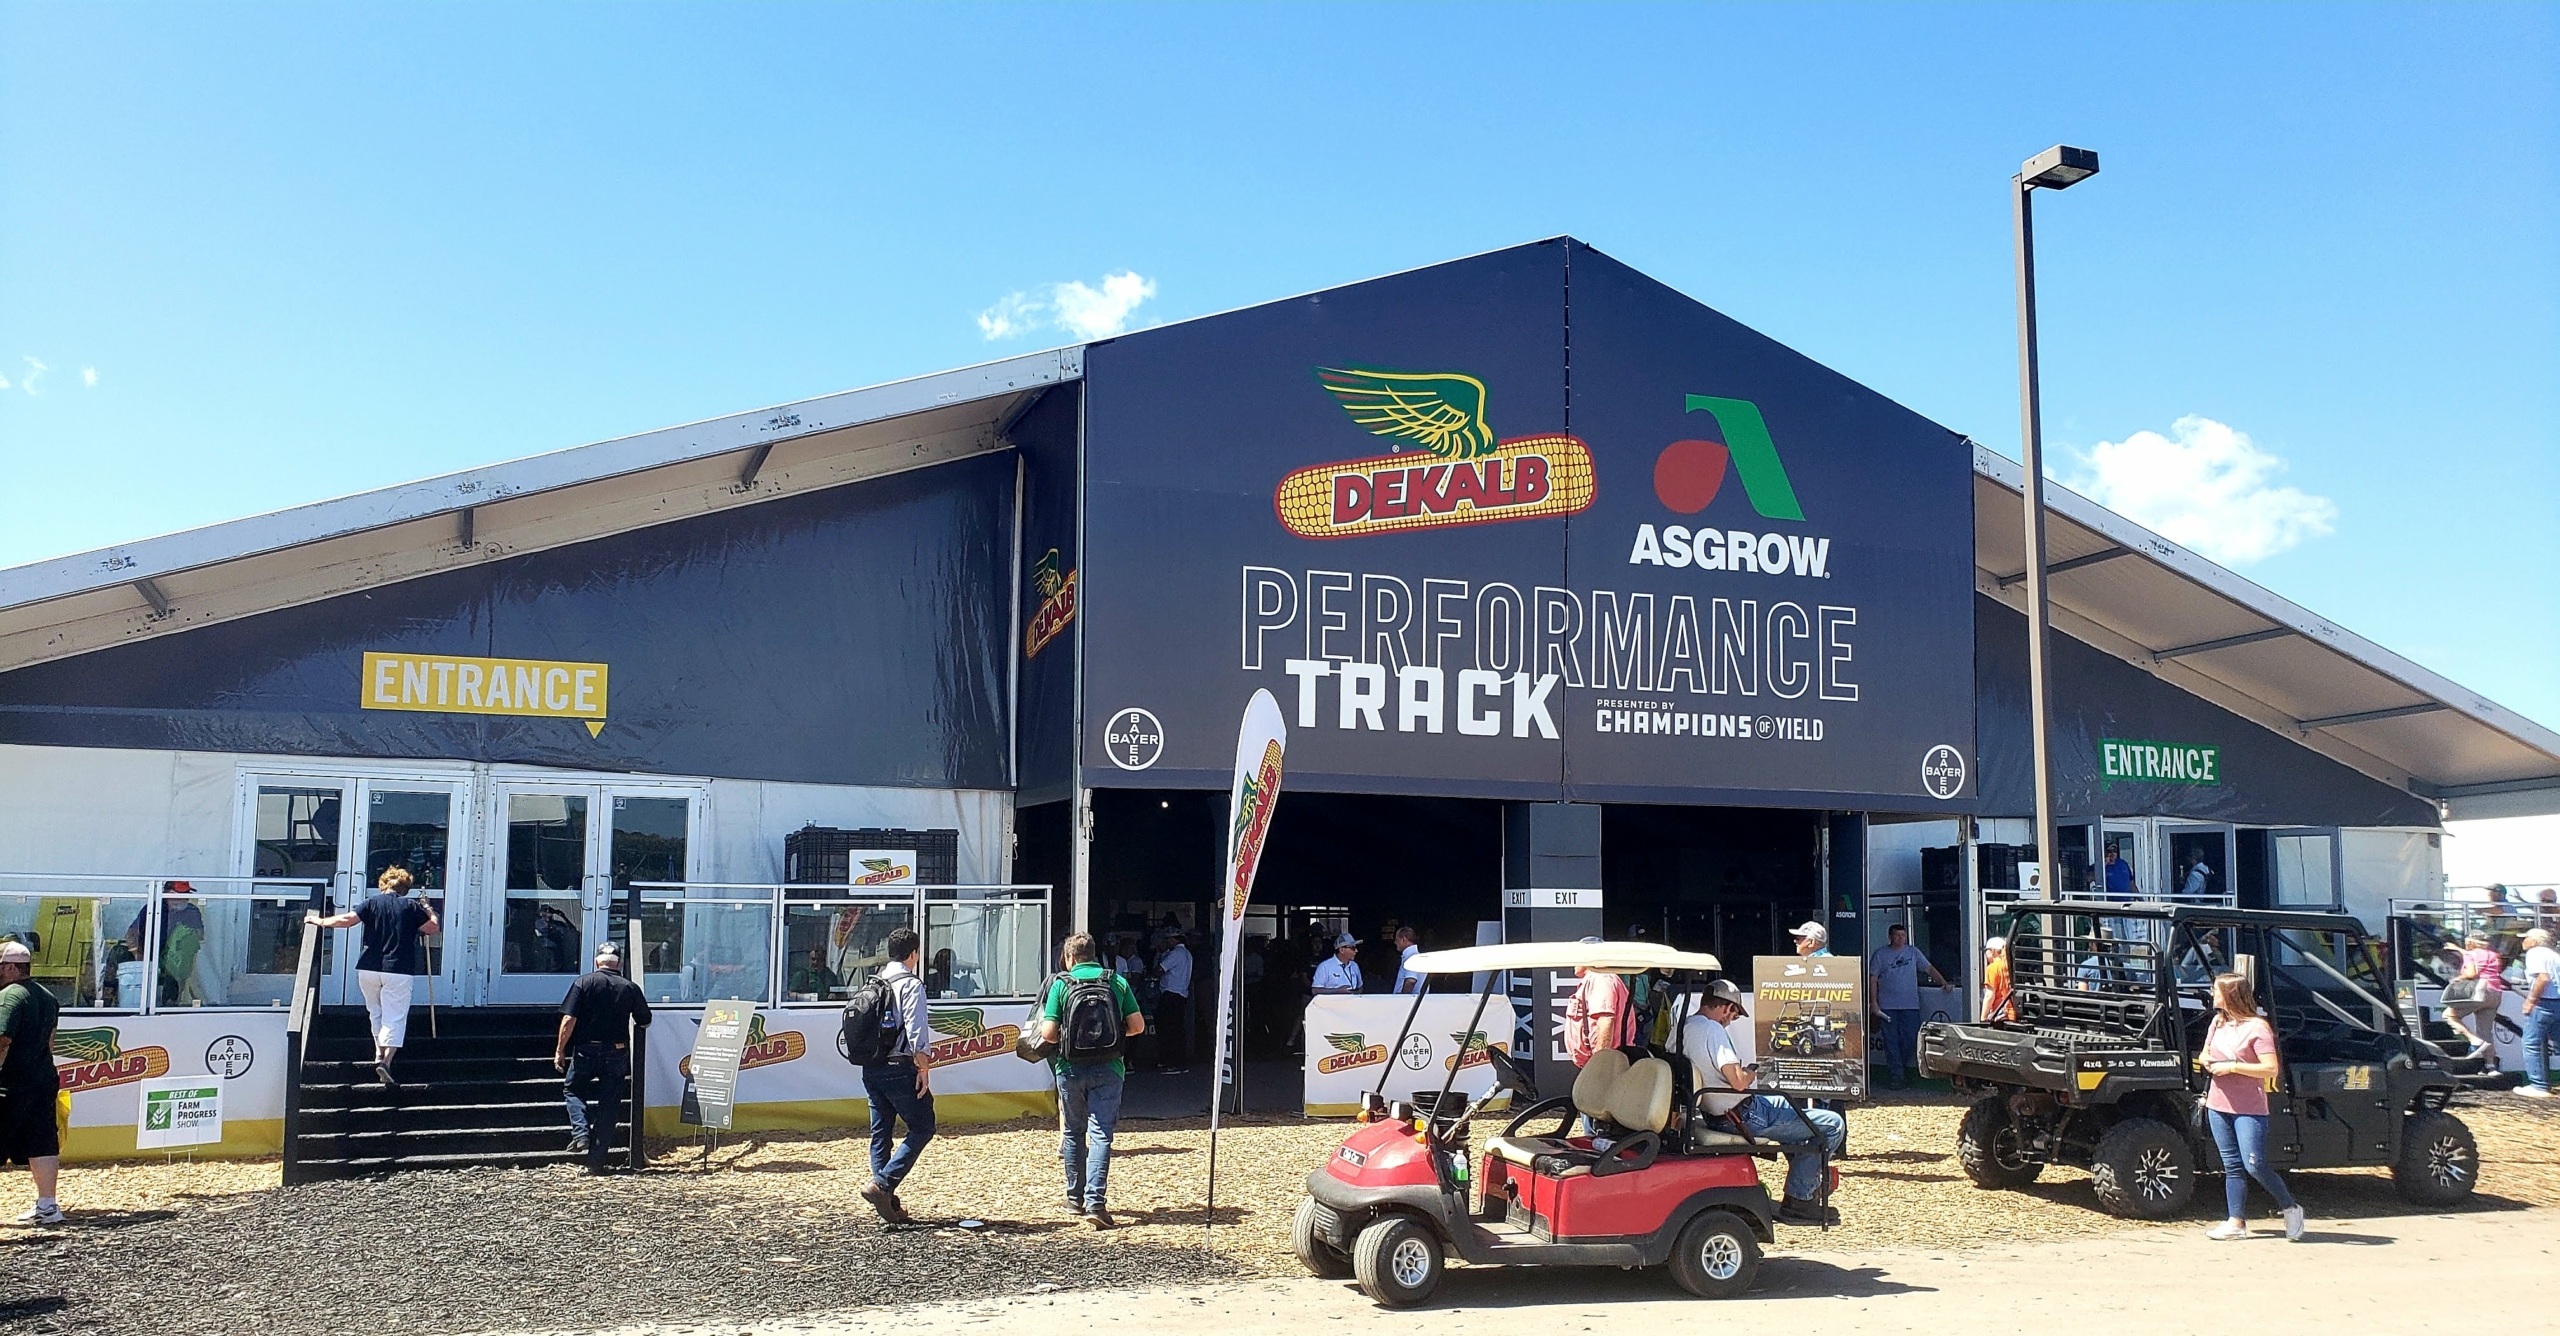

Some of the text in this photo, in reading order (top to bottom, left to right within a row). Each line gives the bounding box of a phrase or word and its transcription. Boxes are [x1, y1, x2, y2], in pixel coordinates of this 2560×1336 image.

[1332, 455, 1548, 526] DEKALB
[1629, 523, 1830, 578] ASGROW
[1033, 582, 1075, 649] DEKALB
[1242, 565, 1859, 702] PERFORMANCE
[374, 660, 597, 712] ENTRANCE
[1285, 659, 1561, 740] TRACK
[1597, 699, 1675, 710] PRESENTED BY
[1596, 710, 1823, 741] CHAMPIONS OF YIELD
[1110, 733, 1158, 745] BAYER
[1129, 713, 1140, 765] BAYER
[2103, 743, 2215, 780] ENTRANCE
[1926, 766, 1961, 777] BAYER
[1940, 750, 1948, 795] BAYER
[1235, 764, 1277, 893] DEKALB
[864, 869, 903, 885] DEKALB
[1511, 892, 1526, 905] EXIT
[1555, 892, 1578, 905] EXIT
[1835, 911, 1856, 919] ASGROW
[1760, 989, 1853, 1001] FINISH LINE
[1510, 970, 1534, 1061] EXIT
[209, 1053, 249, 1061] BAYER
[226, 1039, 235, 1076] BAYER
[1330, 1051, 1377, 1070] DEKALB
[1402, 1048, 1430, 1056] BAYER
[1956, 1042, 2021, 1067] Kawasaki
[59, 1056, 147, 1089] EKALB
[2083, 1060, 2102, 1068] 4x4
[2140, 1058, 2177, 1068] Kawasaki
[2343, 1065, 2370, 1089] 14
[168, 1090, 199, 1099] BEST OF
[177, 1109, 217, 1120] PROGRESS
[178, 1101, 200, 1110] FARM
[177, 1119, 198, 1129] SHOW
